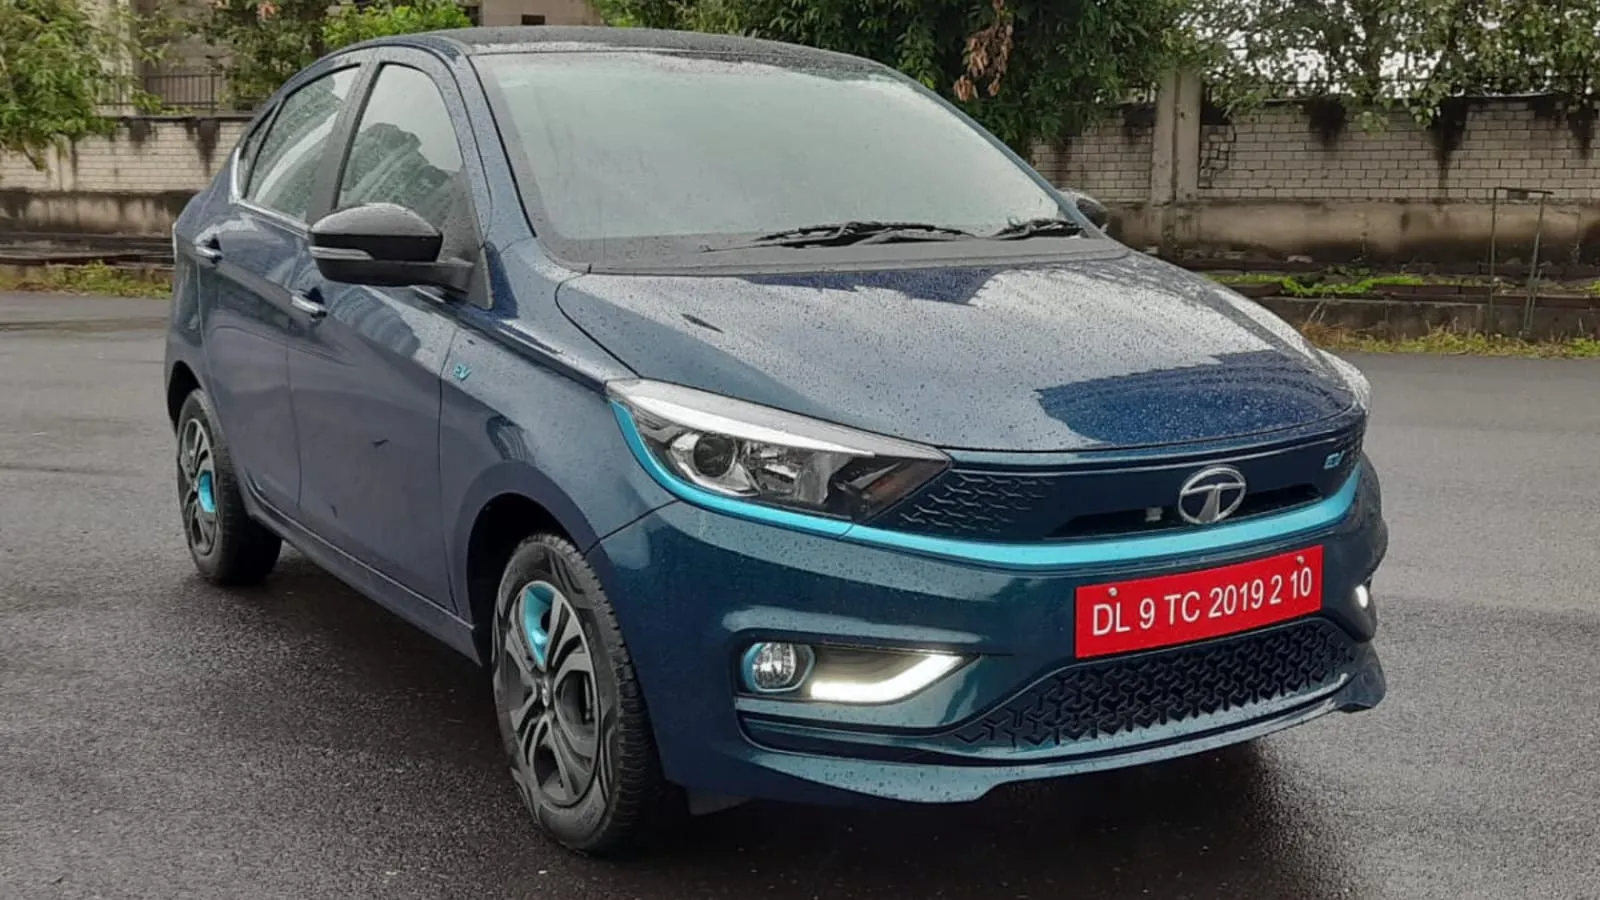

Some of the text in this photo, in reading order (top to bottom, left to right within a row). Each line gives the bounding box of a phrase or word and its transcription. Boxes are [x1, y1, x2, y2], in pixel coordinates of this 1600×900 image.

[1092, 567, 1312, 636] DL 9 TC 2019 2 10
